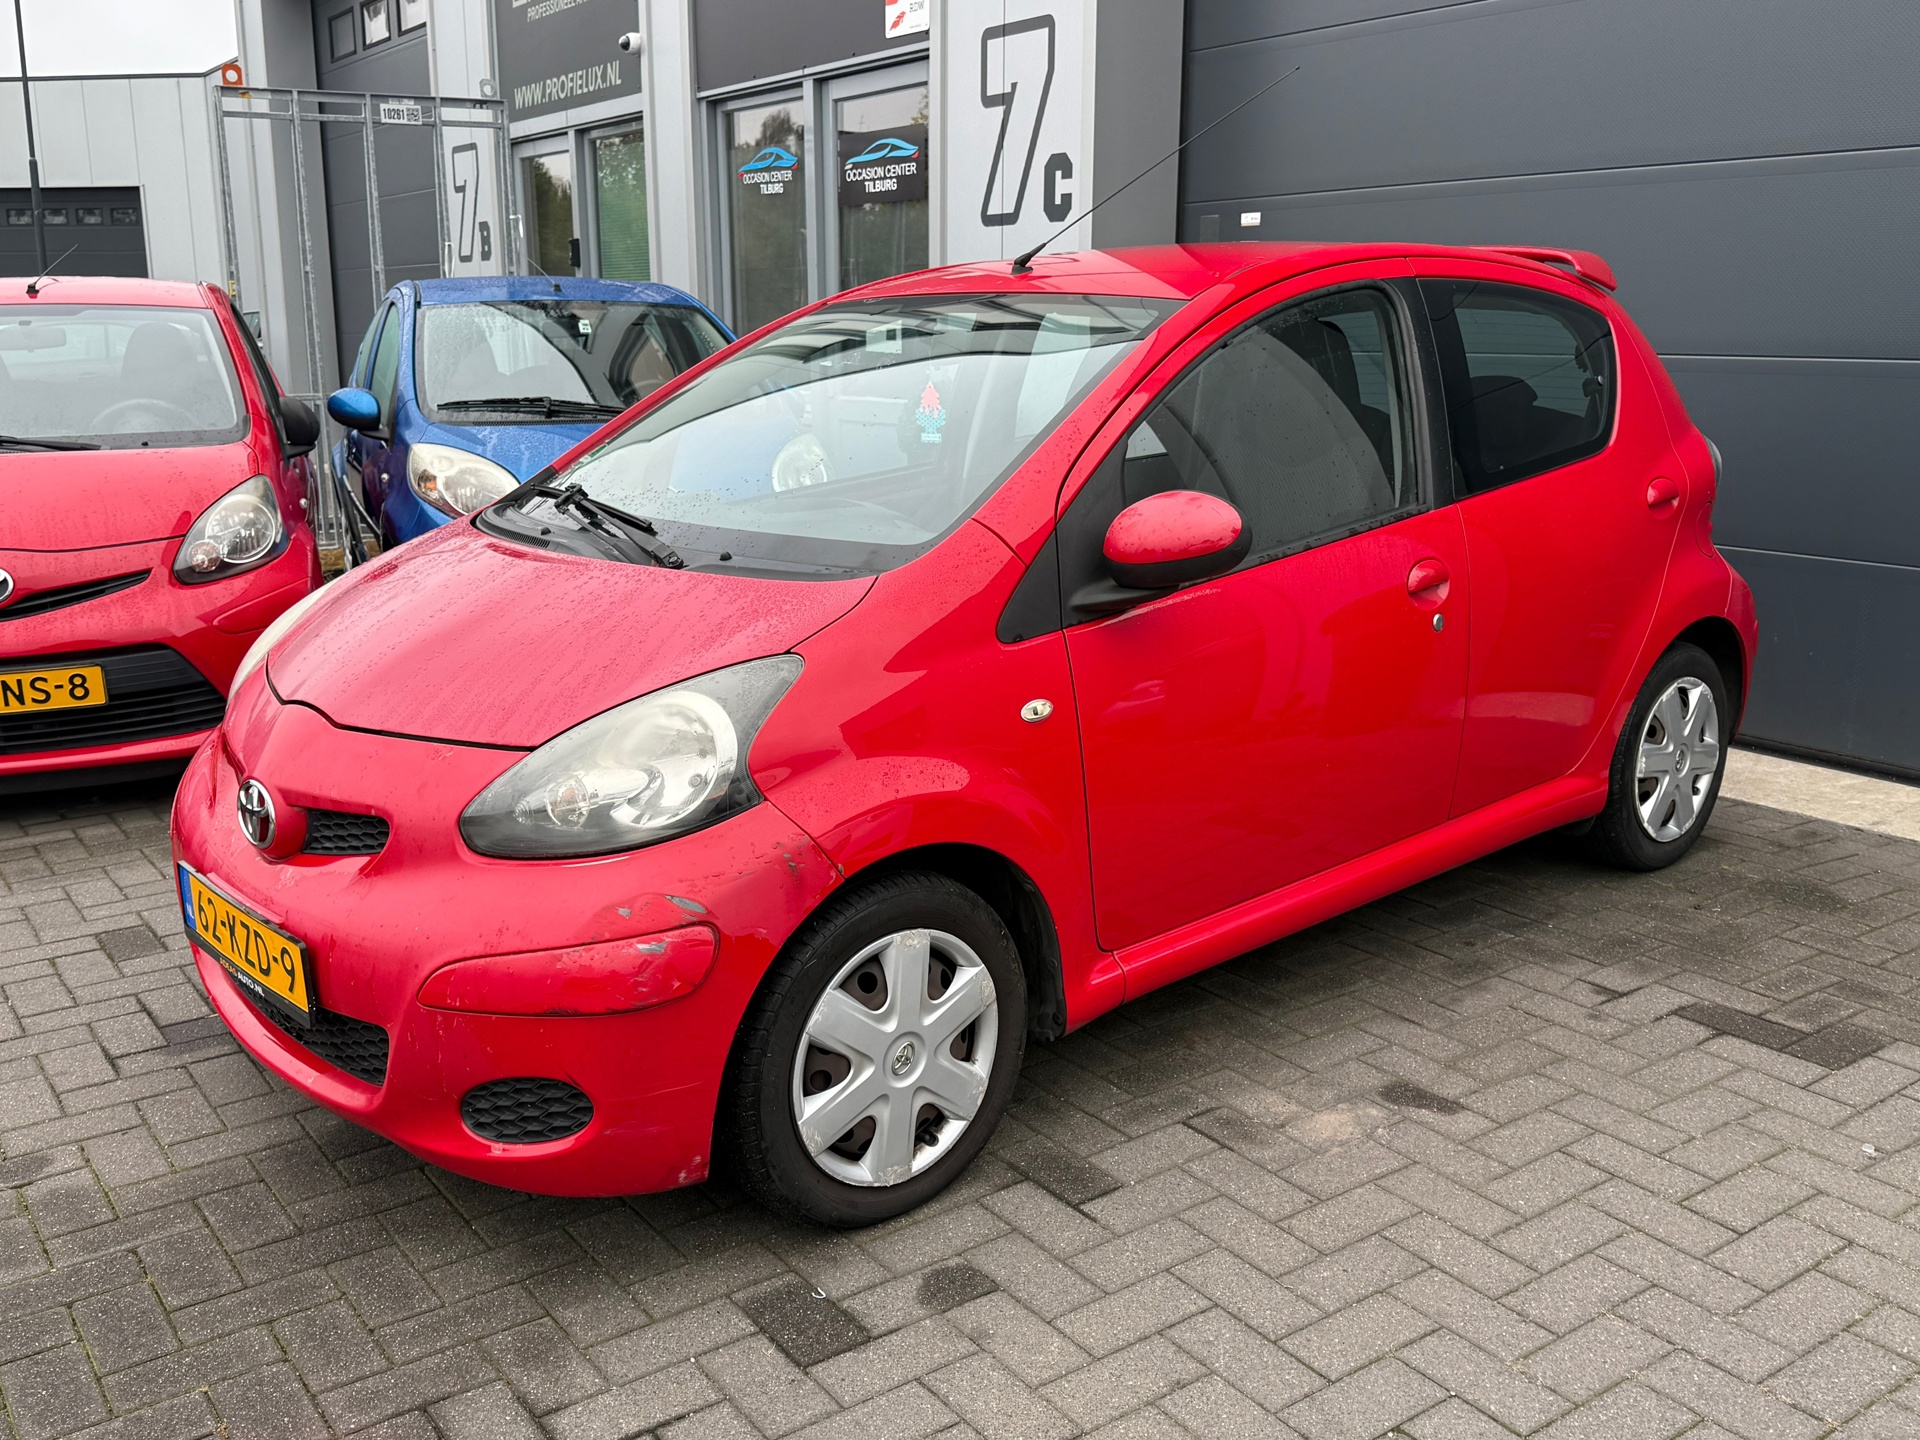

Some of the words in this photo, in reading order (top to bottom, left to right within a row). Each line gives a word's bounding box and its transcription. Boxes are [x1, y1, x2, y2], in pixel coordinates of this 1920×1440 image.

[514, 60, 622, 110] WWW.PROFIELUX.NL
[743, 172, 769, 185] OCCASION
[770, 170, 793, 182] CENTER
[846, 167, 885, 182] OCCASION
[885, 162, 917, 178] CENTER
[760, 183, 784, 195] TILBURG
[864, 178, 897, 193] TILBURG
[198, 889, 296, 995] 62-KZD-9
